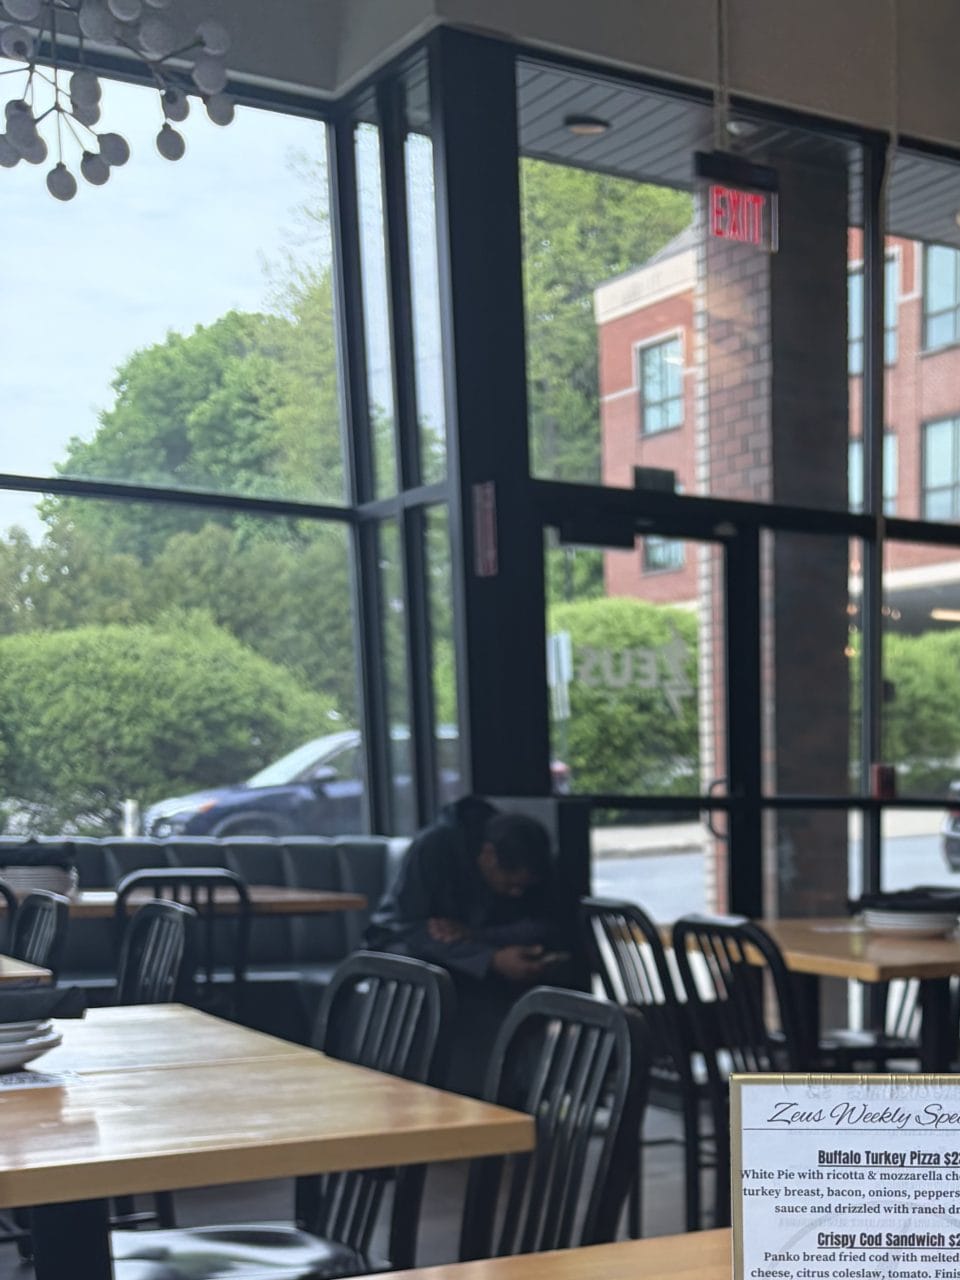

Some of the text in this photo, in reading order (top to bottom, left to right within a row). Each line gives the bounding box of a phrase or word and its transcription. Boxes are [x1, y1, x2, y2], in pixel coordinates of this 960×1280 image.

[711, 185, 765, 244] EXIT
[766, 1101, 826, 1126] Zeus
[829, 1101, 913, 1130] Weekly
[817, 1149, 863, 1166] Buffalo
[863, 1149, 908, 1167] Turkey
[909, 1149, 942, 1167] Pizza
[741, 1167, 774, 1181] White
[777, 1168, 796, 1181] Pie
[796, 1168, 825, 1181] with
[826, 1168, 866, 1181] ricotta
[867, 1170, 878, 1181] &
[879, 1169, 944, 1182] mozzarella
[742, 1184, 782, 1199] turkey
[783, 1185, 825, 1200] breast,
[826, 1186, 867, 1200] bacon,
[867, 1186, 912, 1200] onions,
[774, 1205, 809, 1214] sauce
[809, 1202, 833, 1215] and
[833, 1202, 882, 1215] drizzled
[882, 1203, 910, 1215] with
[911, 1203, 947, 1215] ranch
[817, 1231, 857, 1249] Crispy
[859, 1231, 883, 1248] Cod
[885, 1231, 947, 1248] Sandwich
[763, 1251, 801, 1263] Panko
[802, 1251, 837, 1263] bread
[838, 1251, 867, 1263] fried
[868, 1251, 890, 1263] cod
[891, 1251, 919, 1263] with
[919, 1251, 960, 1264] melted
[750, 1267, 795, 1280] cheese,
[795, 1267, 831, 1279] citrus
[831, 1267, 886, 1280] coleslaw,
[887, 1269, 933, 1280] tomato.
